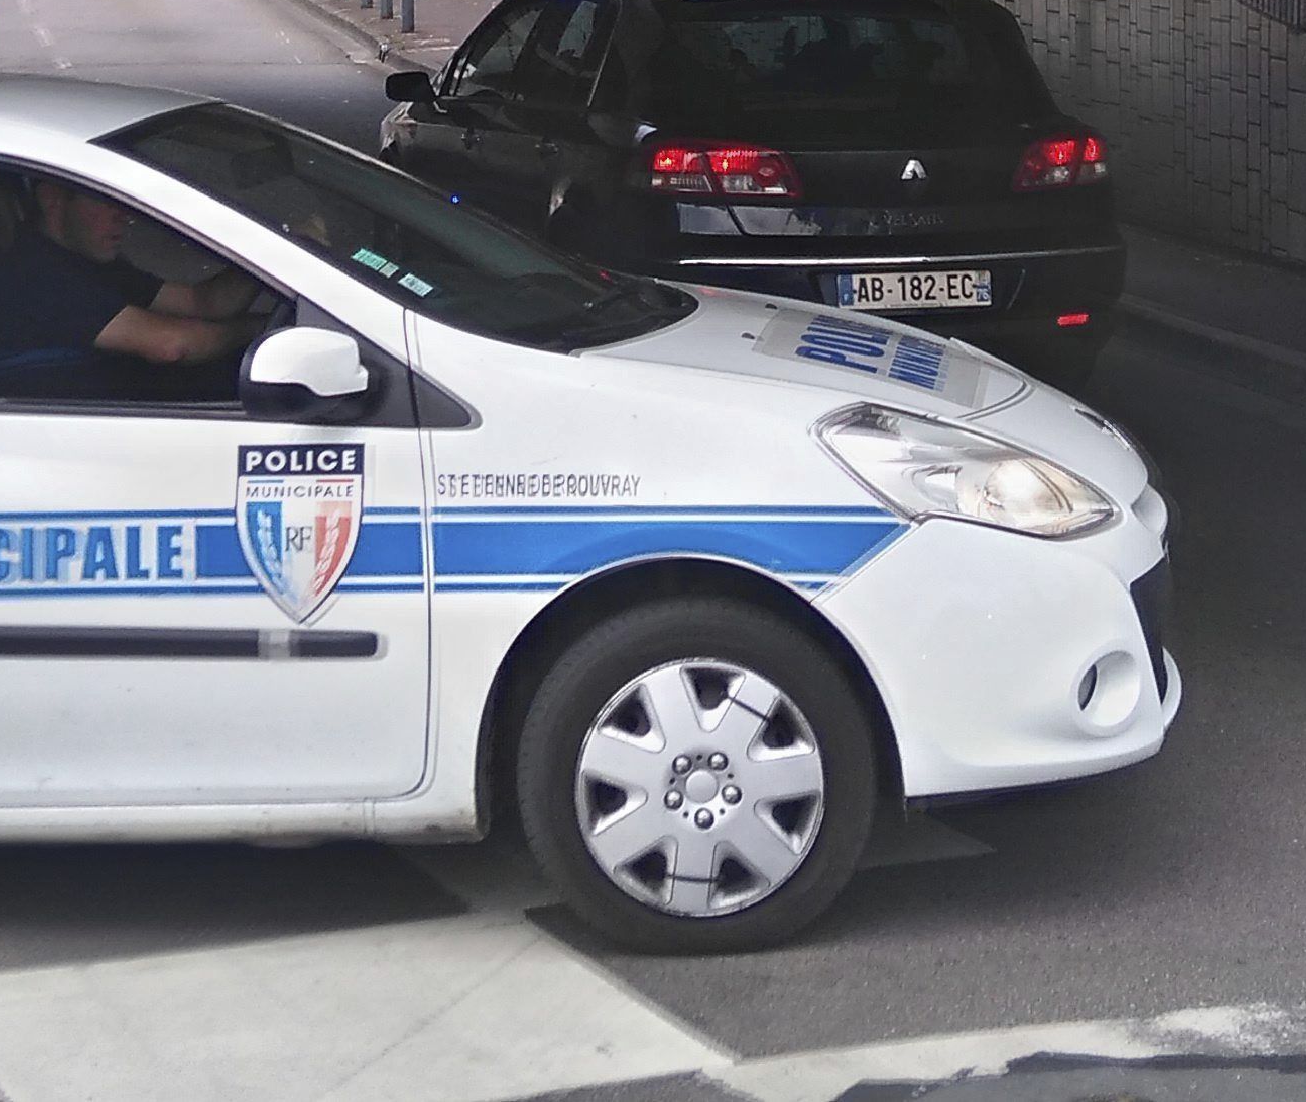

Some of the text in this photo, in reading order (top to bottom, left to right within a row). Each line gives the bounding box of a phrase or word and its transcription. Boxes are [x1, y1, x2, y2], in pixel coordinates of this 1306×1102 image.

[856, 274, 974, 303] AB-182-EC
[245, 449, 357, 472] POLICE
[245, 484, 355, 498] MUNICIPALE
[285, 525, 312, 552] RF
